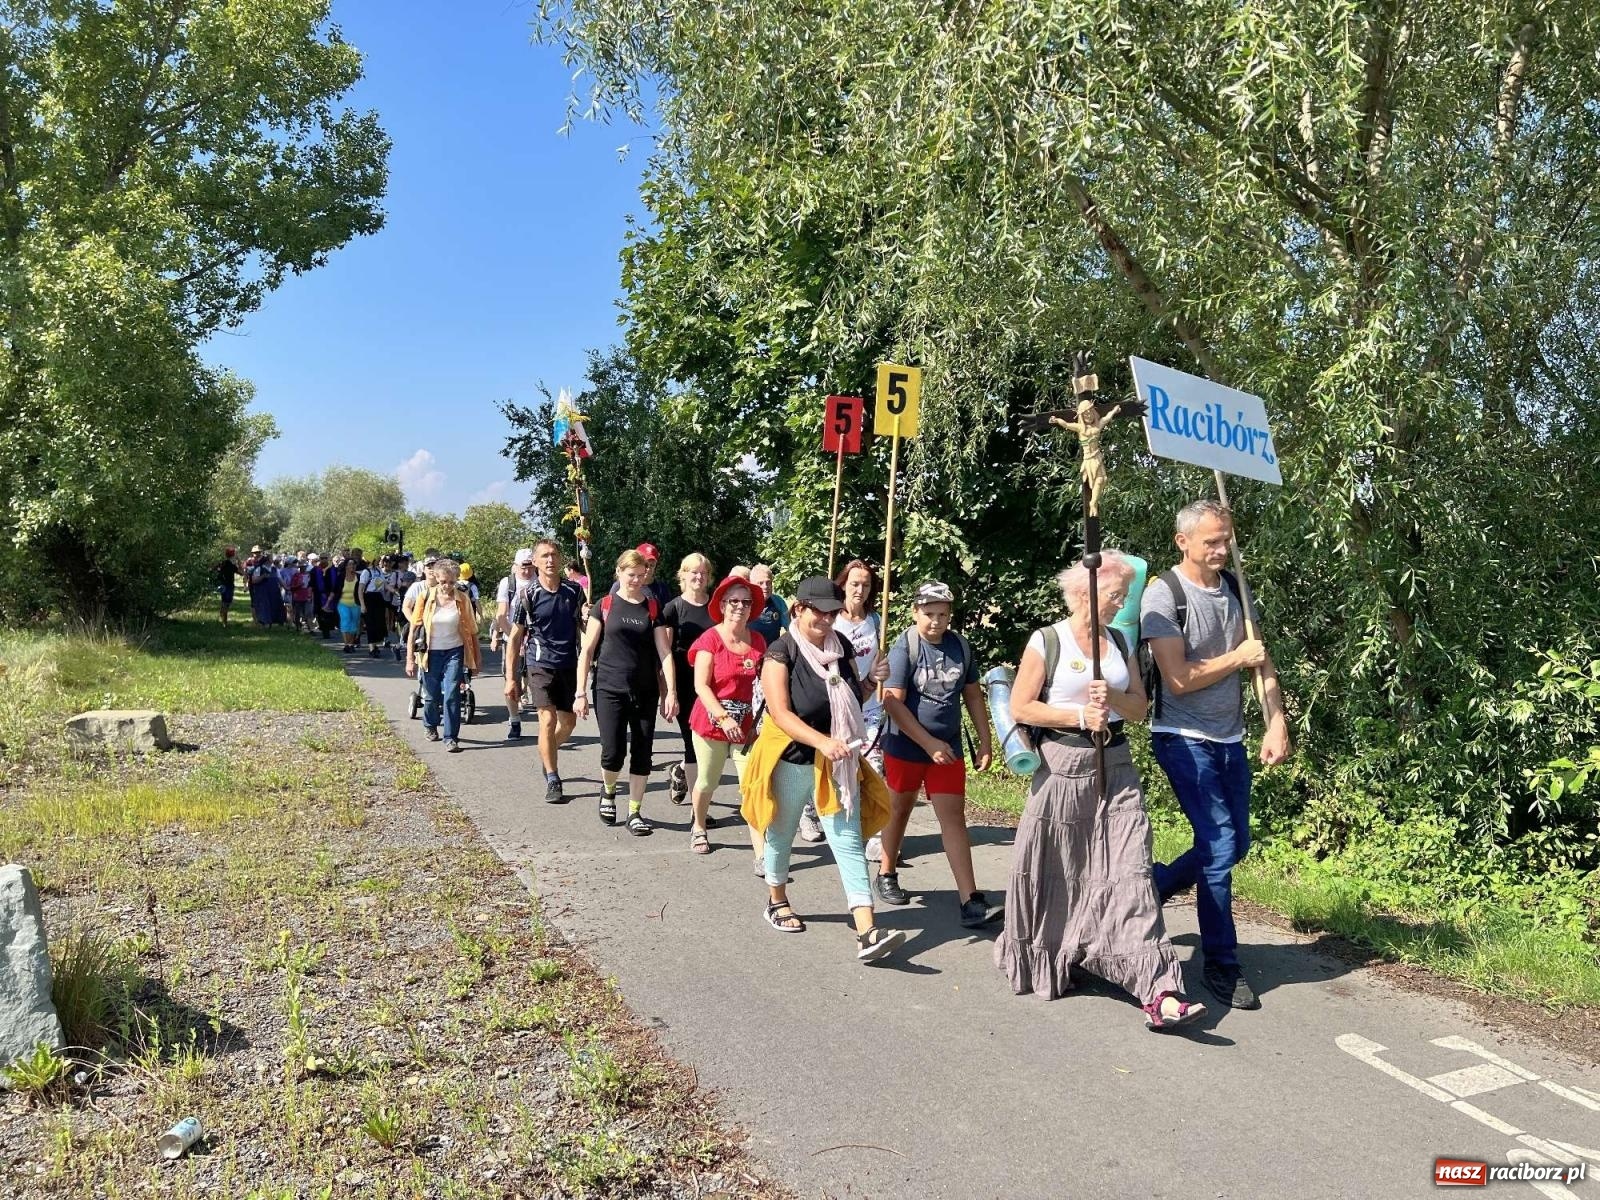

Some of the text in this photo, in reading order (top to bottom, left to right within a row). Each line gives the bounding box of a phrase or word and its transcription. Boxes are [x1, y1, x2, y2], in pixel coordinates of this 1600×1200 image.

[887, 372, 909, 415] 5
[834, 402, 853, 435] 5
[1146, 384, 1275, 465] Racibórz
